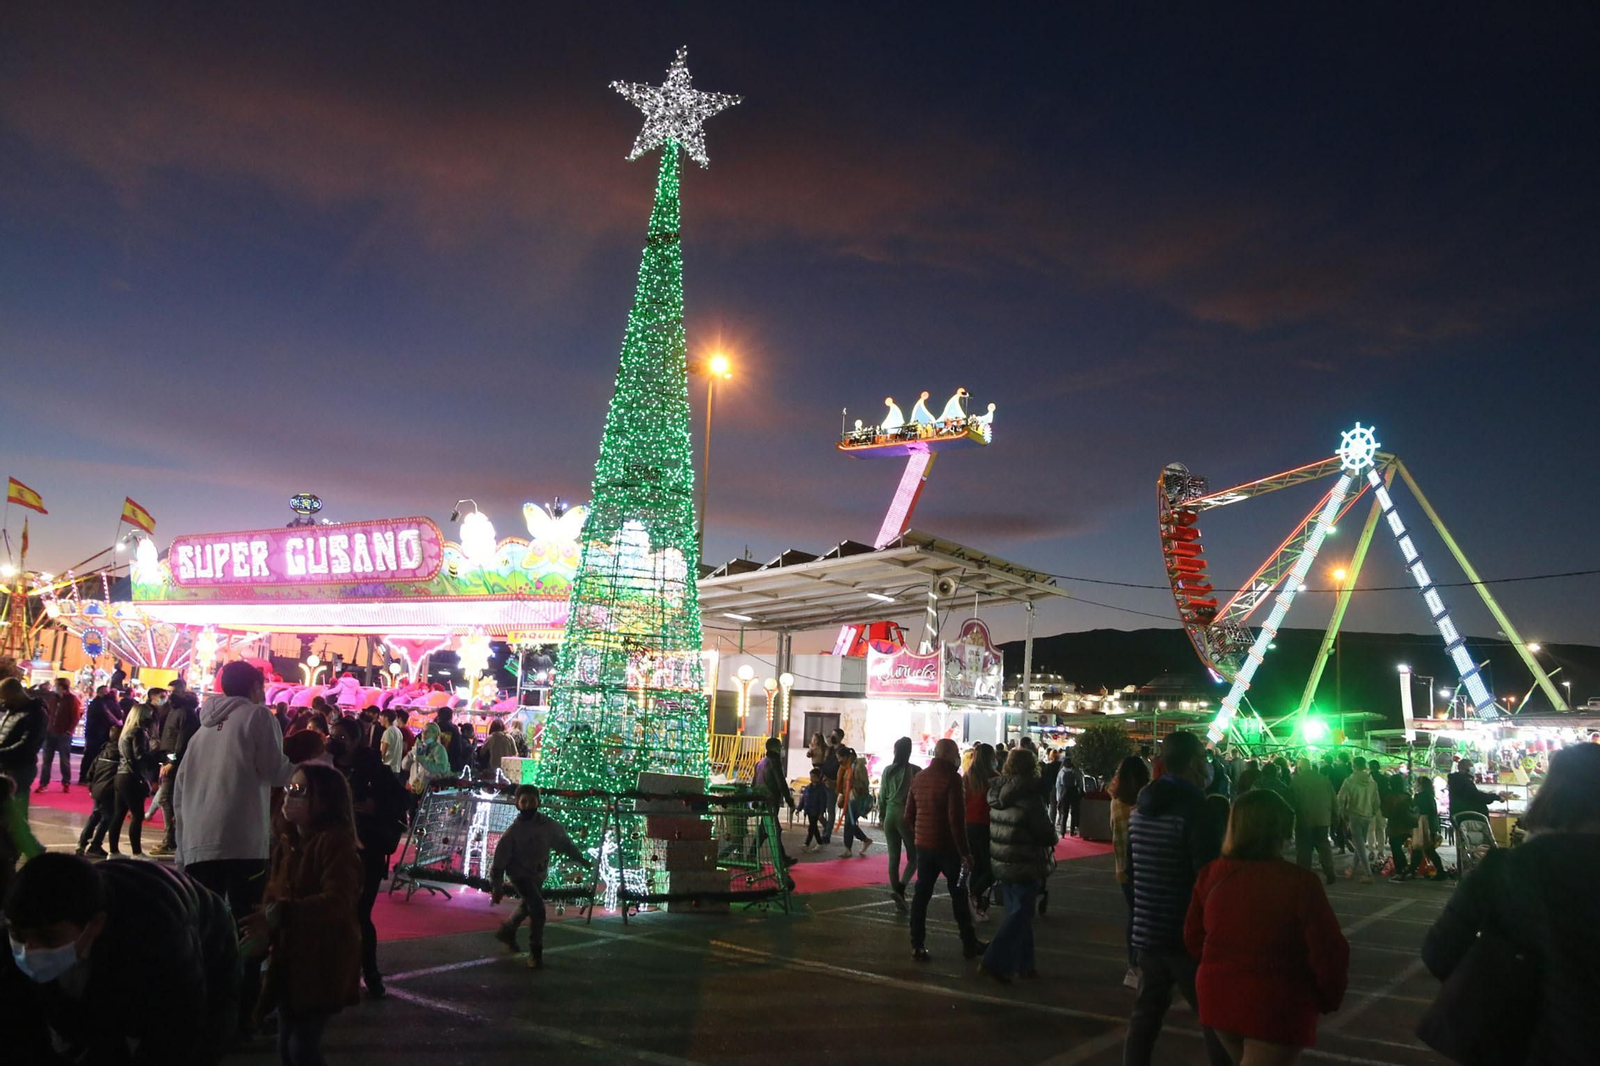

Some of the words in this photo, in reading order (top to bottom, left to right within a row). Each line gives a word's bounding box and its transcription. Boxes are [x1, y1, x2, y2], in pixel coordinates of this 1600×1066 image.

[177, 540, 270, 580] SUPER
[286, 529, 423, 576] GUSANO
[513, 632, 563, 640] TAQUILL
